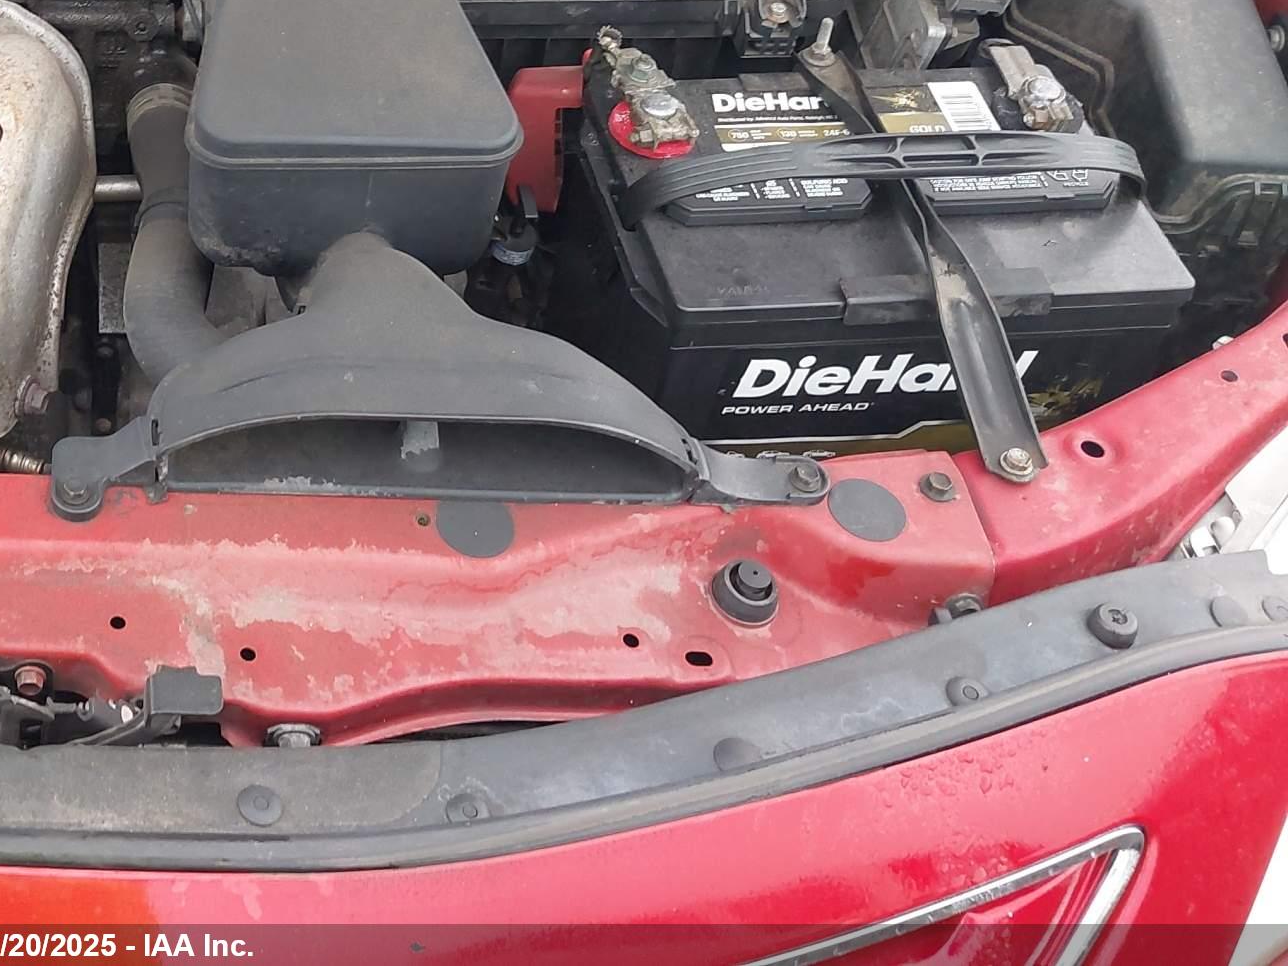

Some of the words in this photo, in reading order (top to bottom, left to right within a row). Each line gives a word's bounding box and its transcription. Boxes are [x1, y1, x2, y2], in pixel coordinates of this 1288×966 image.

[711, 92, 829, 112] DieHar
[909, 124, 946, 134] GOLD
[721, 403, 793, 415] POWER
[798, 401, 870, 413] AHEAD
